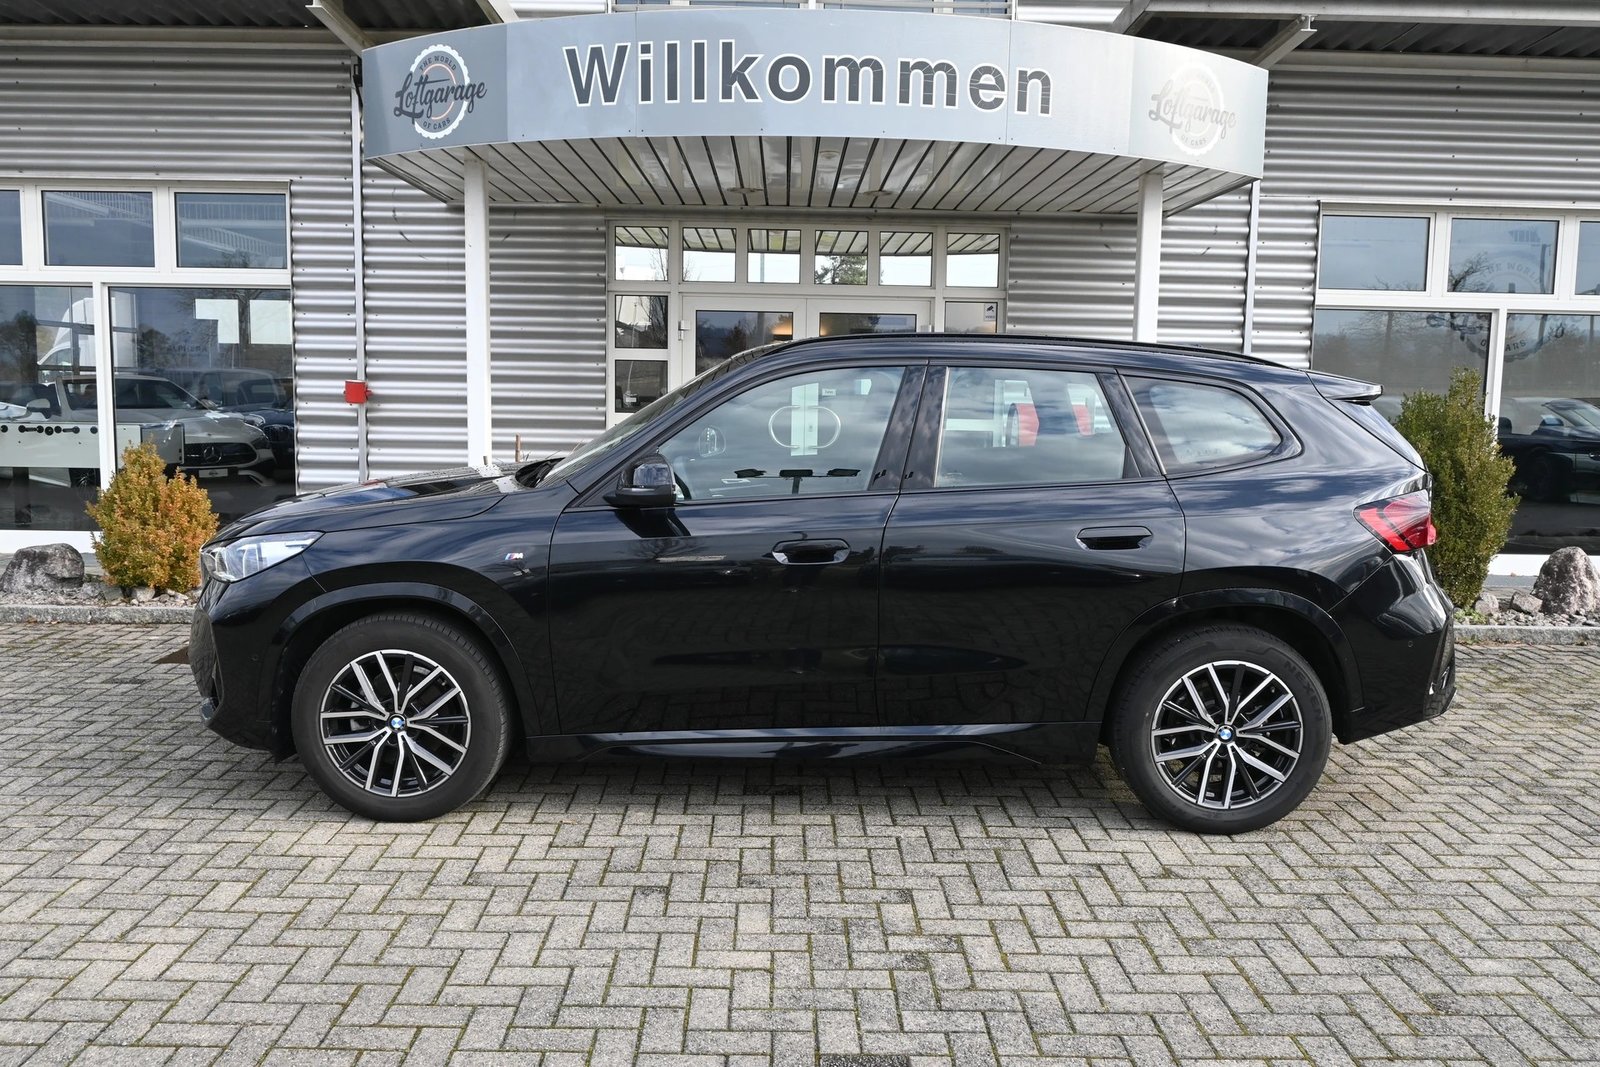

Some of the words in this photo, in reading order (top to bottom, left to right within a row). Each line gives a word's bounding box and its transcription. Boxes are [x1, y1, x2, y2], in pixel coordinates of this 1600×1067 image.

[419, 57, 432, 71] THE
[434, 55, 457, 71] WORLD
[562, 39, 1053, 117] Willkommen
[394, 72, 487, 125] Loftgarage
[422, 120, 431, 129] OF
[433, 117, 451, 130] CARS
[1148, 79, 1236, 139] Loftgarage
